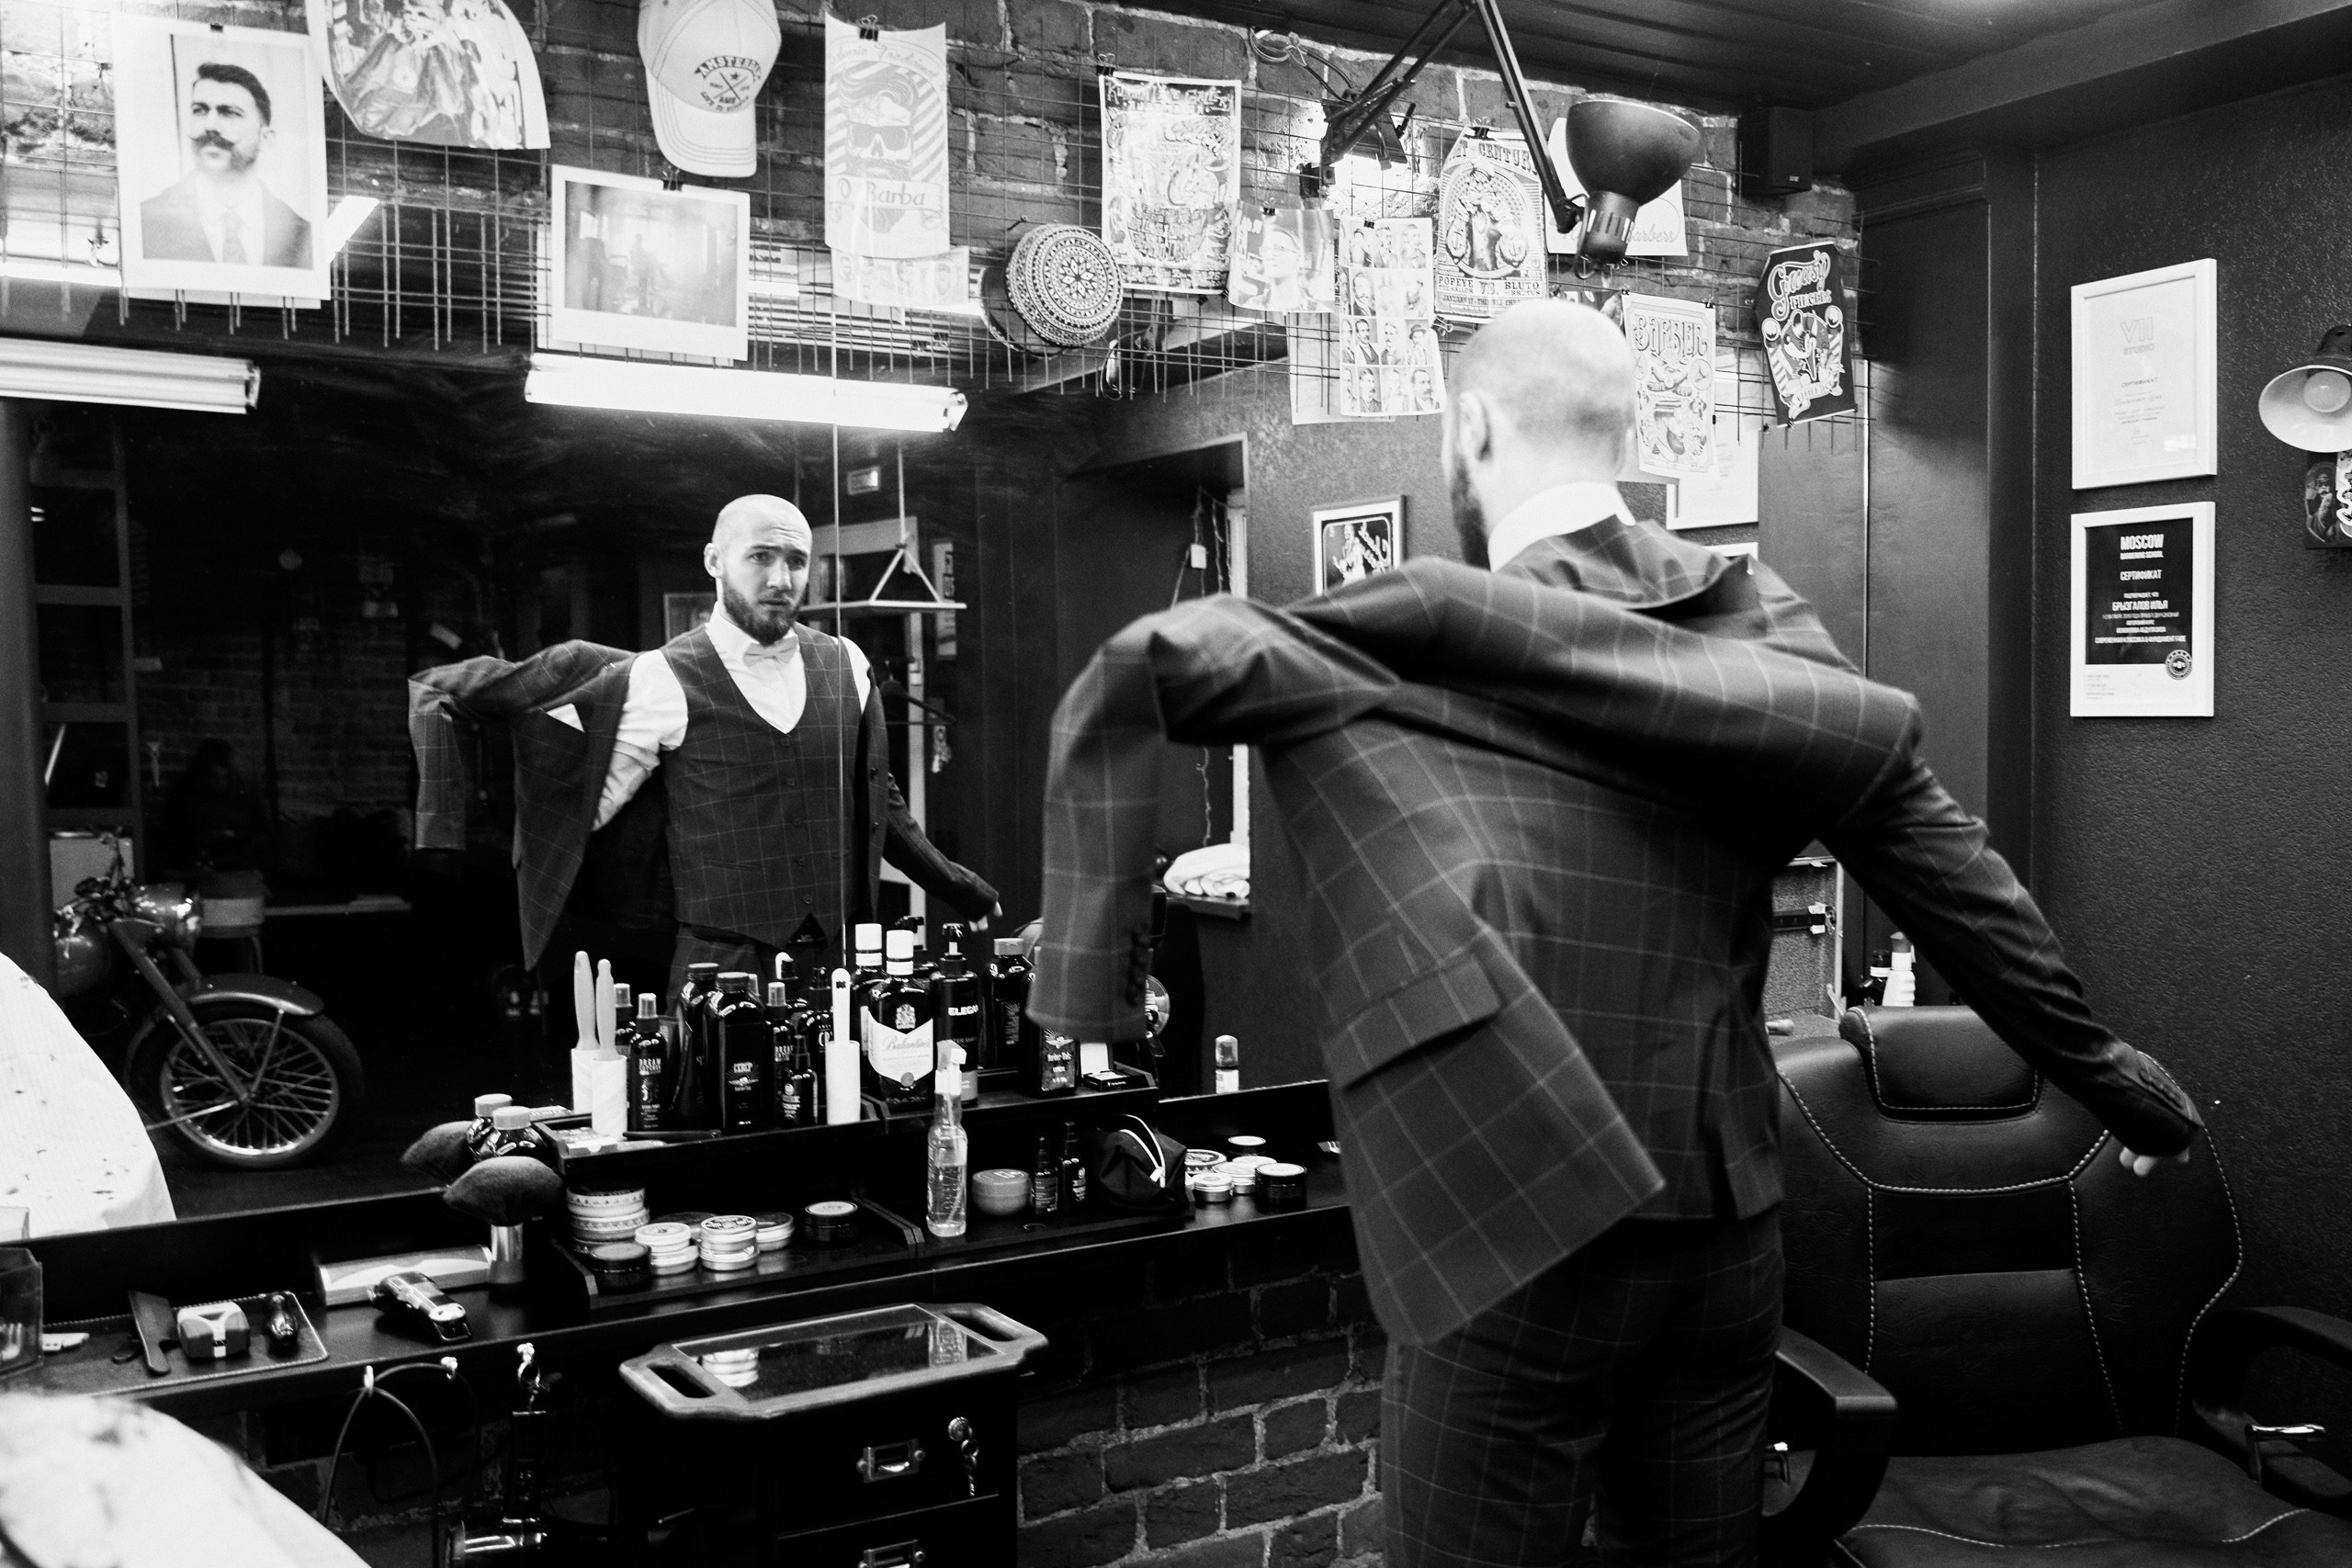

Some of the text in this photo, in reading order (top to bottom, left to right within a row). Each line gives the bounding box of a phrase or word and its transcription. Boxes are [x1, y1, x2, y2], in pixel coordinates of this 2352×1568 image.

[866, 180, 926, 206] Barba
[1439, 276, 1474, 288] POPEYE
[1505, 281, 1540, 290] BLUTO
[1634, 313, 1711, 356] BARBER
[2120, 316, 2154, 344] VII
[2121, 343, 2155, 355] STUDIO
[2120, 534, 2164, 550] MOSCOW
[2120, 570, 2162, 581] СЕРТИФИКАТ
[2112, 600, 2168, 611] БРЫЗГАЛОВ ИЛЬЯ
[639, 1057, 662, 1066] DREAM
